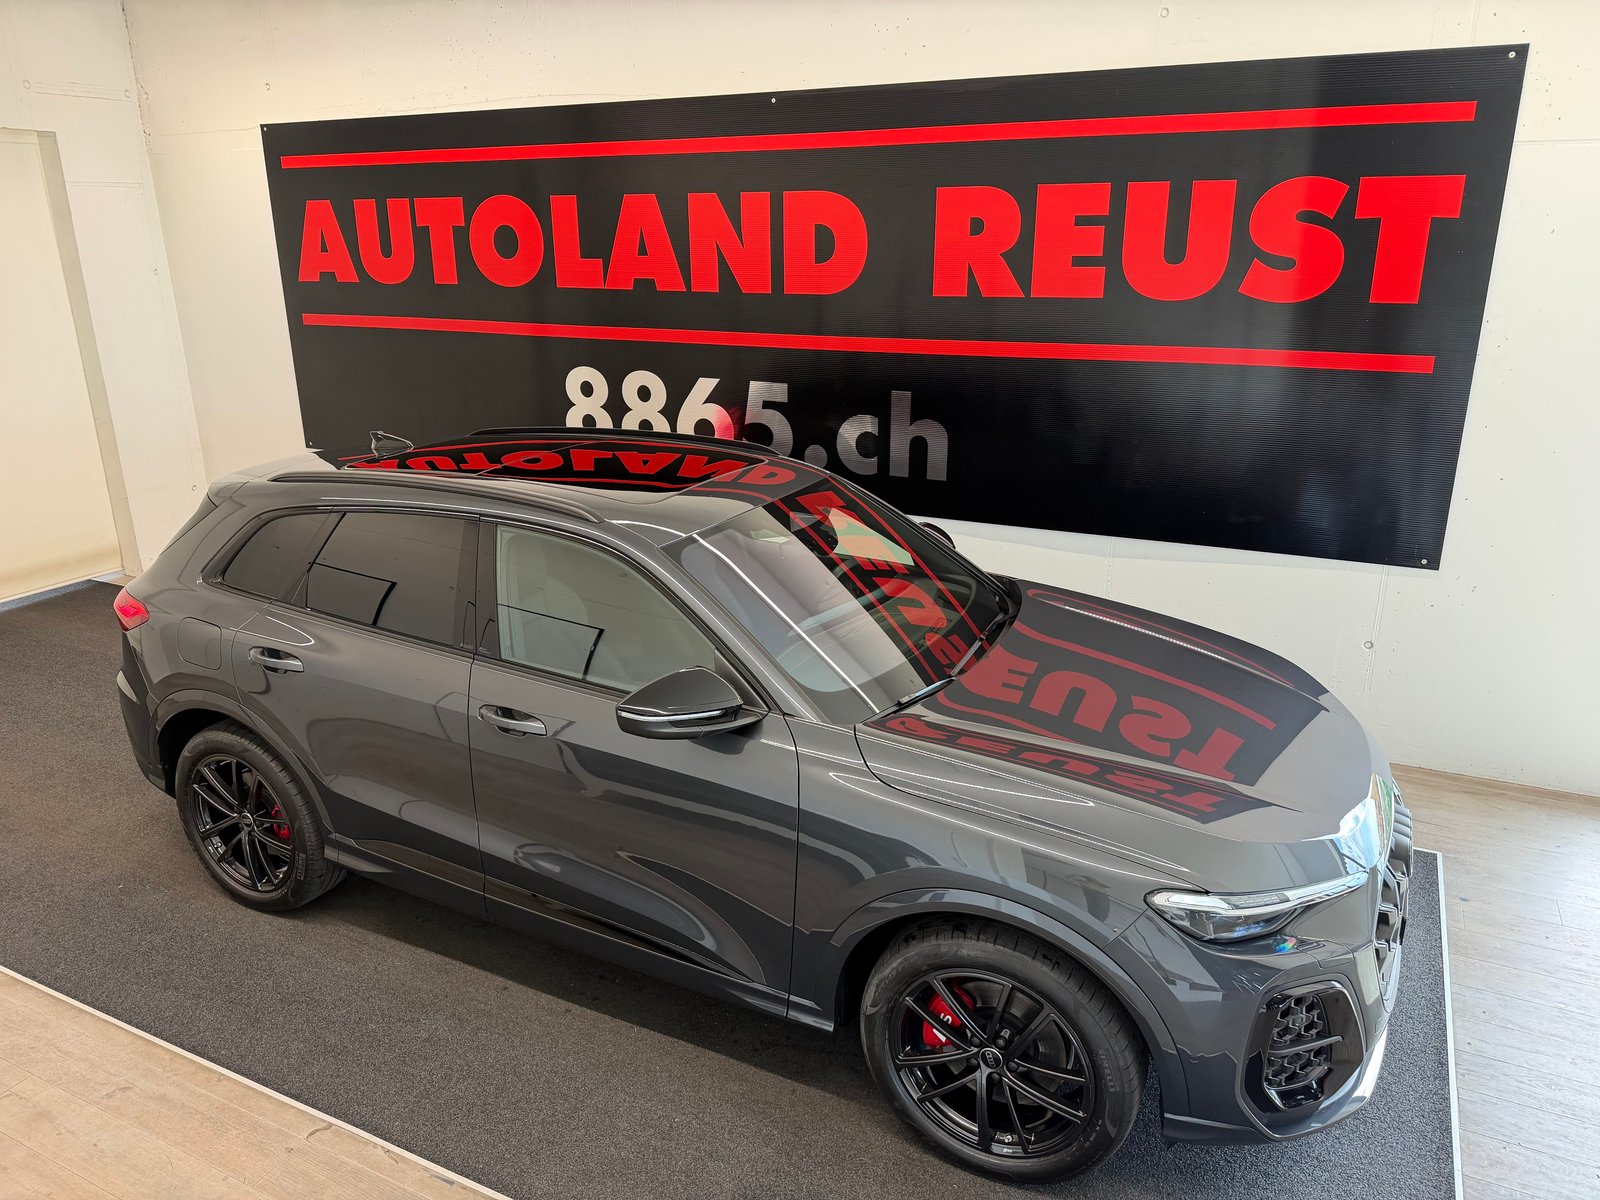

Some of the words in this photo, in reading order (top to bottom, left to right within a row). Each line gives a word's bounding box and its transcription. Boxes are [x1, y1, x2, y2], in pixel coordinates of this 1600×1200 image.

[298, 190, 868, 295] AUTOLAND
[932, 174, 1466, 305] REUST
[565, 366, 949, 482] 8865.ch
